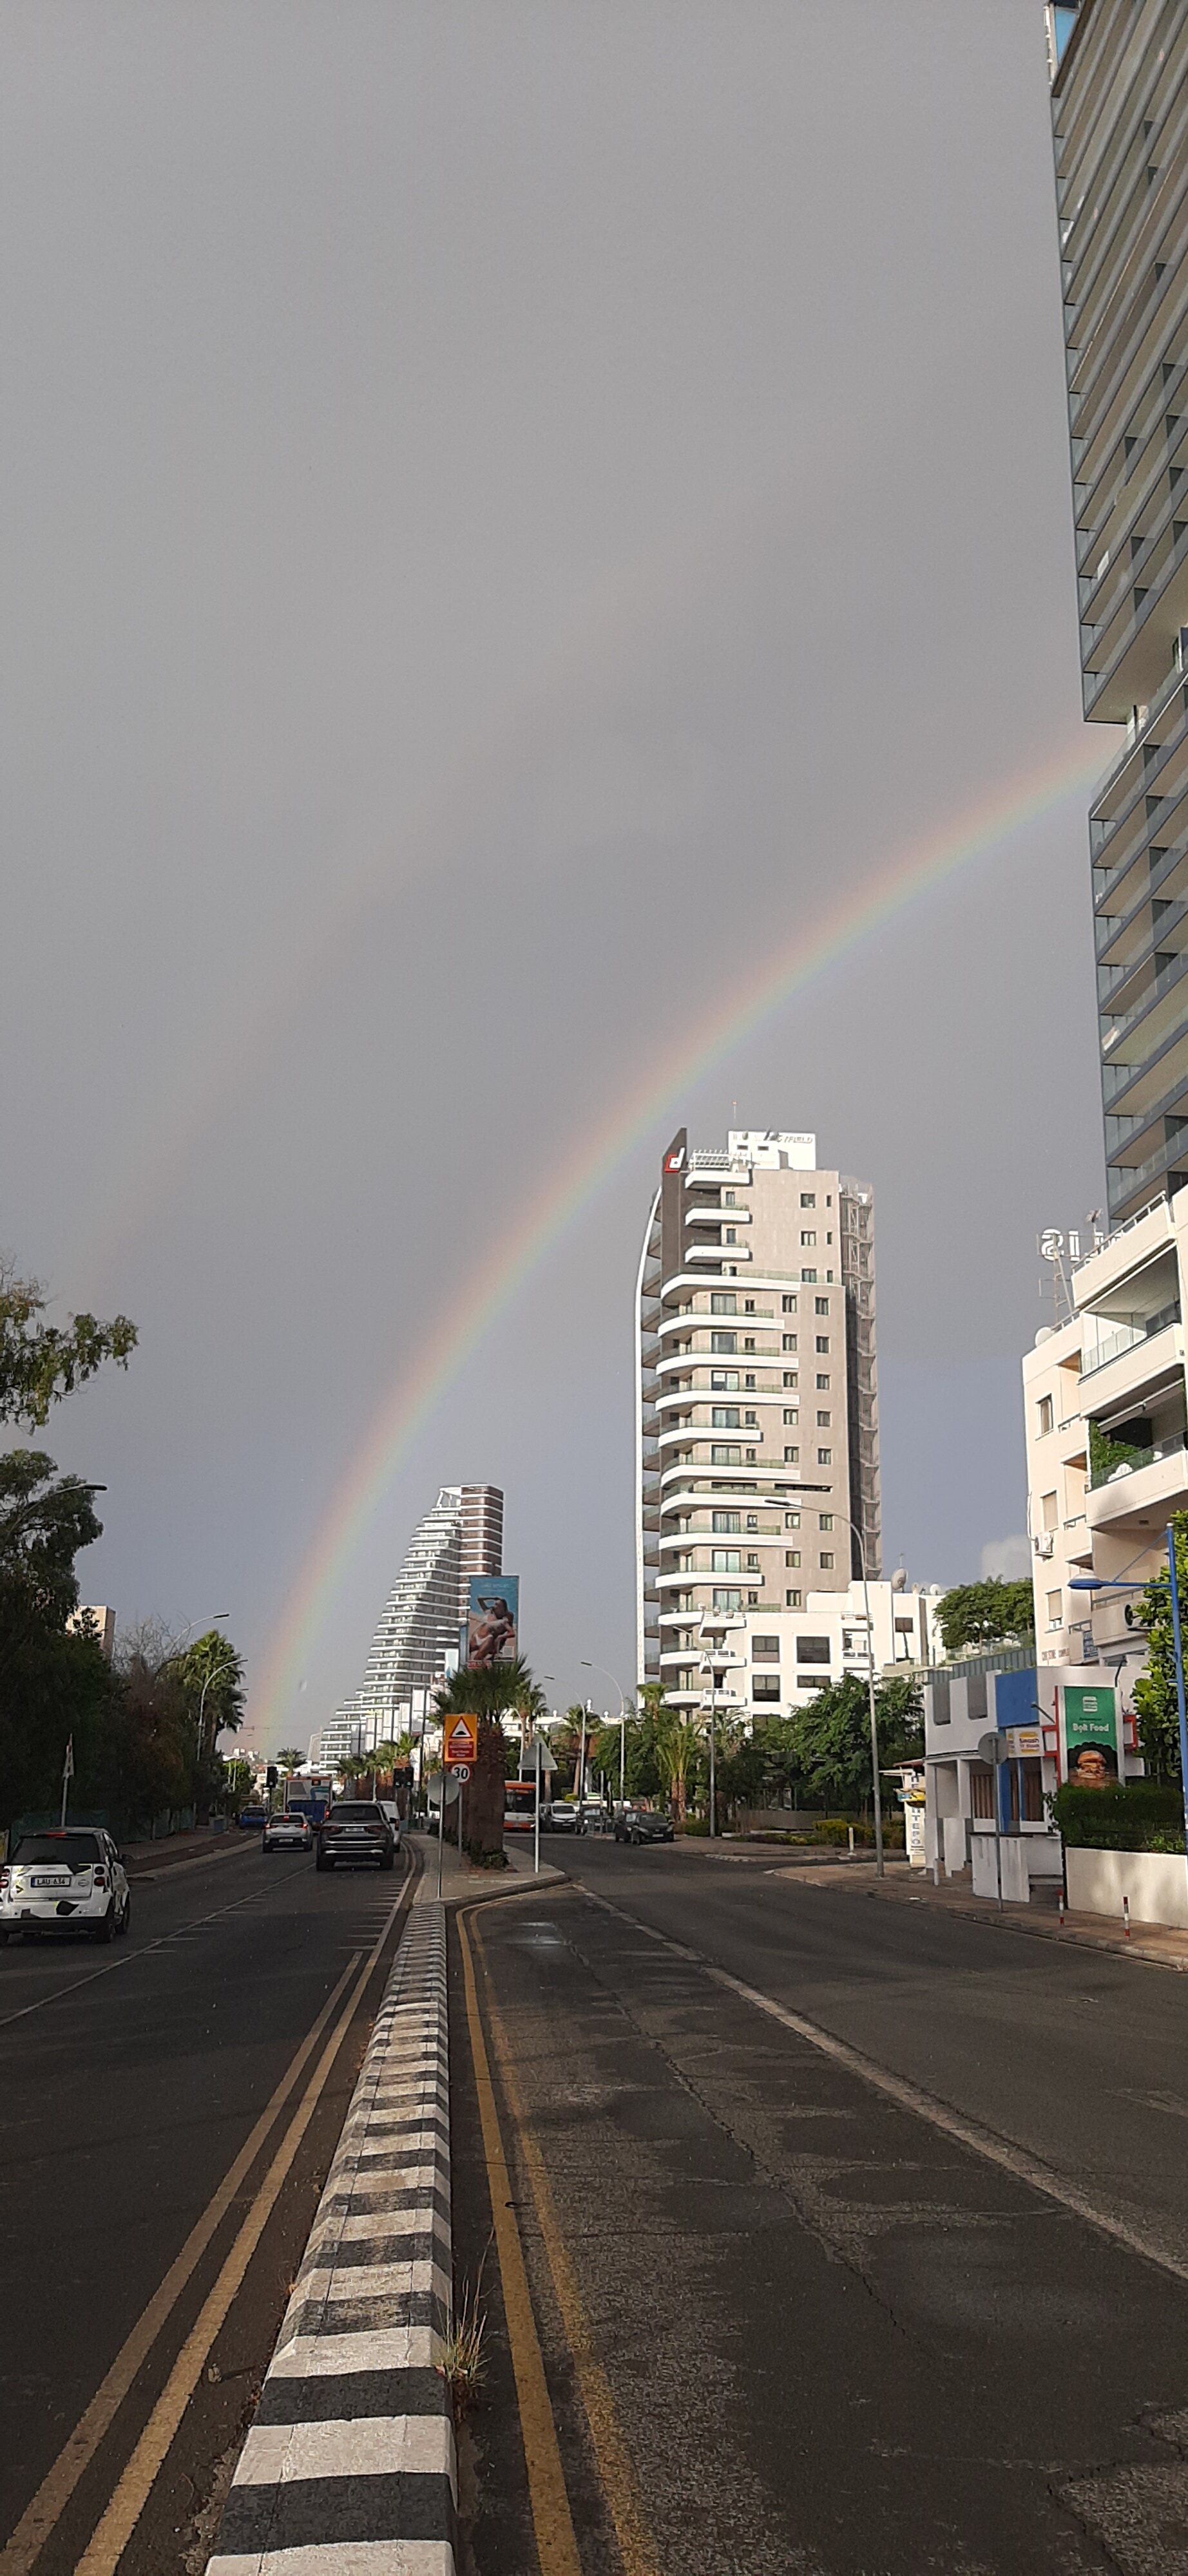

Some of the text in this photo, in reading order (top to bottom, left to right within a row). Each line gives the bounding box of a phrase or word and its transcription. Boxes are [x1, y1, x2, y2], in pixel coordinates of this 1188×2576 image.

[1072, 1723, 1109, 1733] Bolt Food
[454, 1766, 468, 1779] 30
